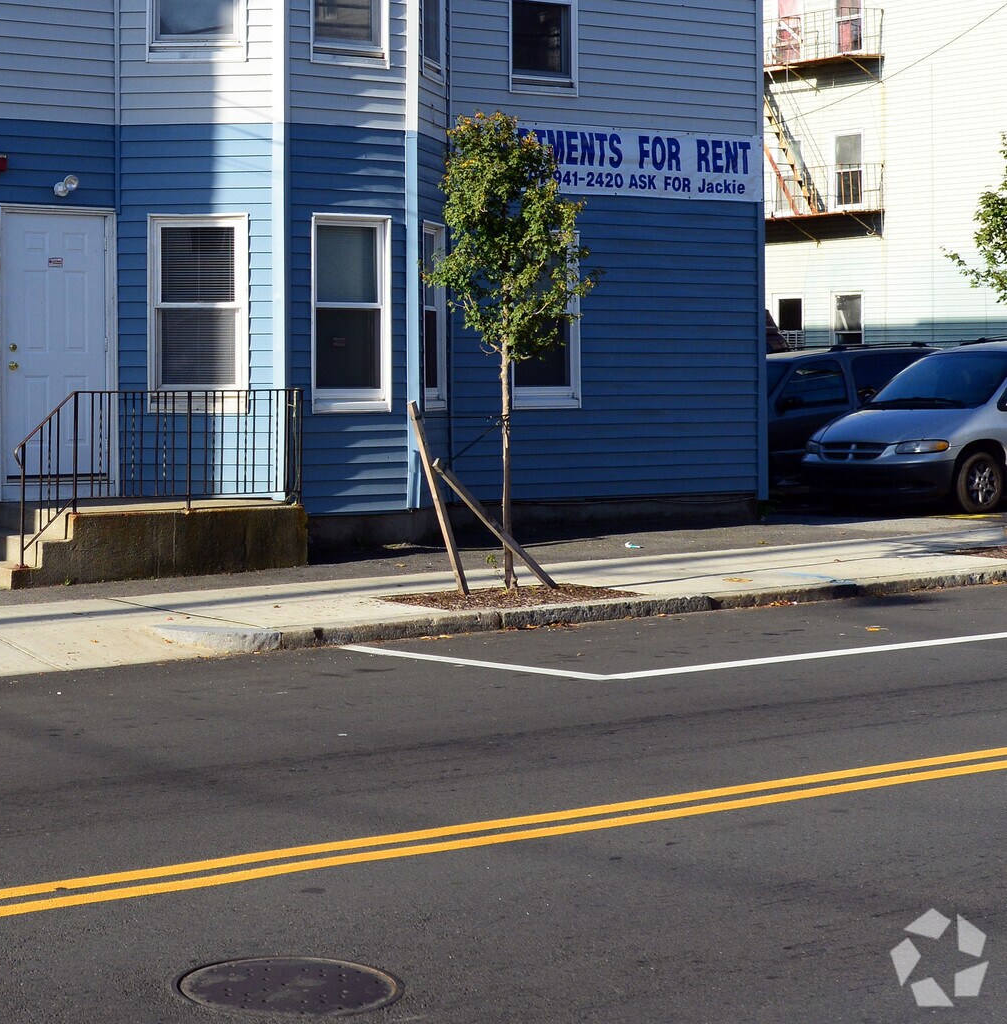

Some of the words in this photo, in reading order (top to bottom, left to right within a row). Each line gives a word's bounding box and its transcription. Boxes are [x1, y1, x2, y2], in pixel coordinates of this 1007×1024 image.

[517, 127, 623, 169] TMENTS
[638, 135, 682, 172] FOR
[696, 139, 751, 175] RENT
[539, 169, 624, 189] 941-2420
[628, 174, 657, 190] ASK
[664, 176, 691, 193] FOR
[698, 178, 746, 194] Jackie
